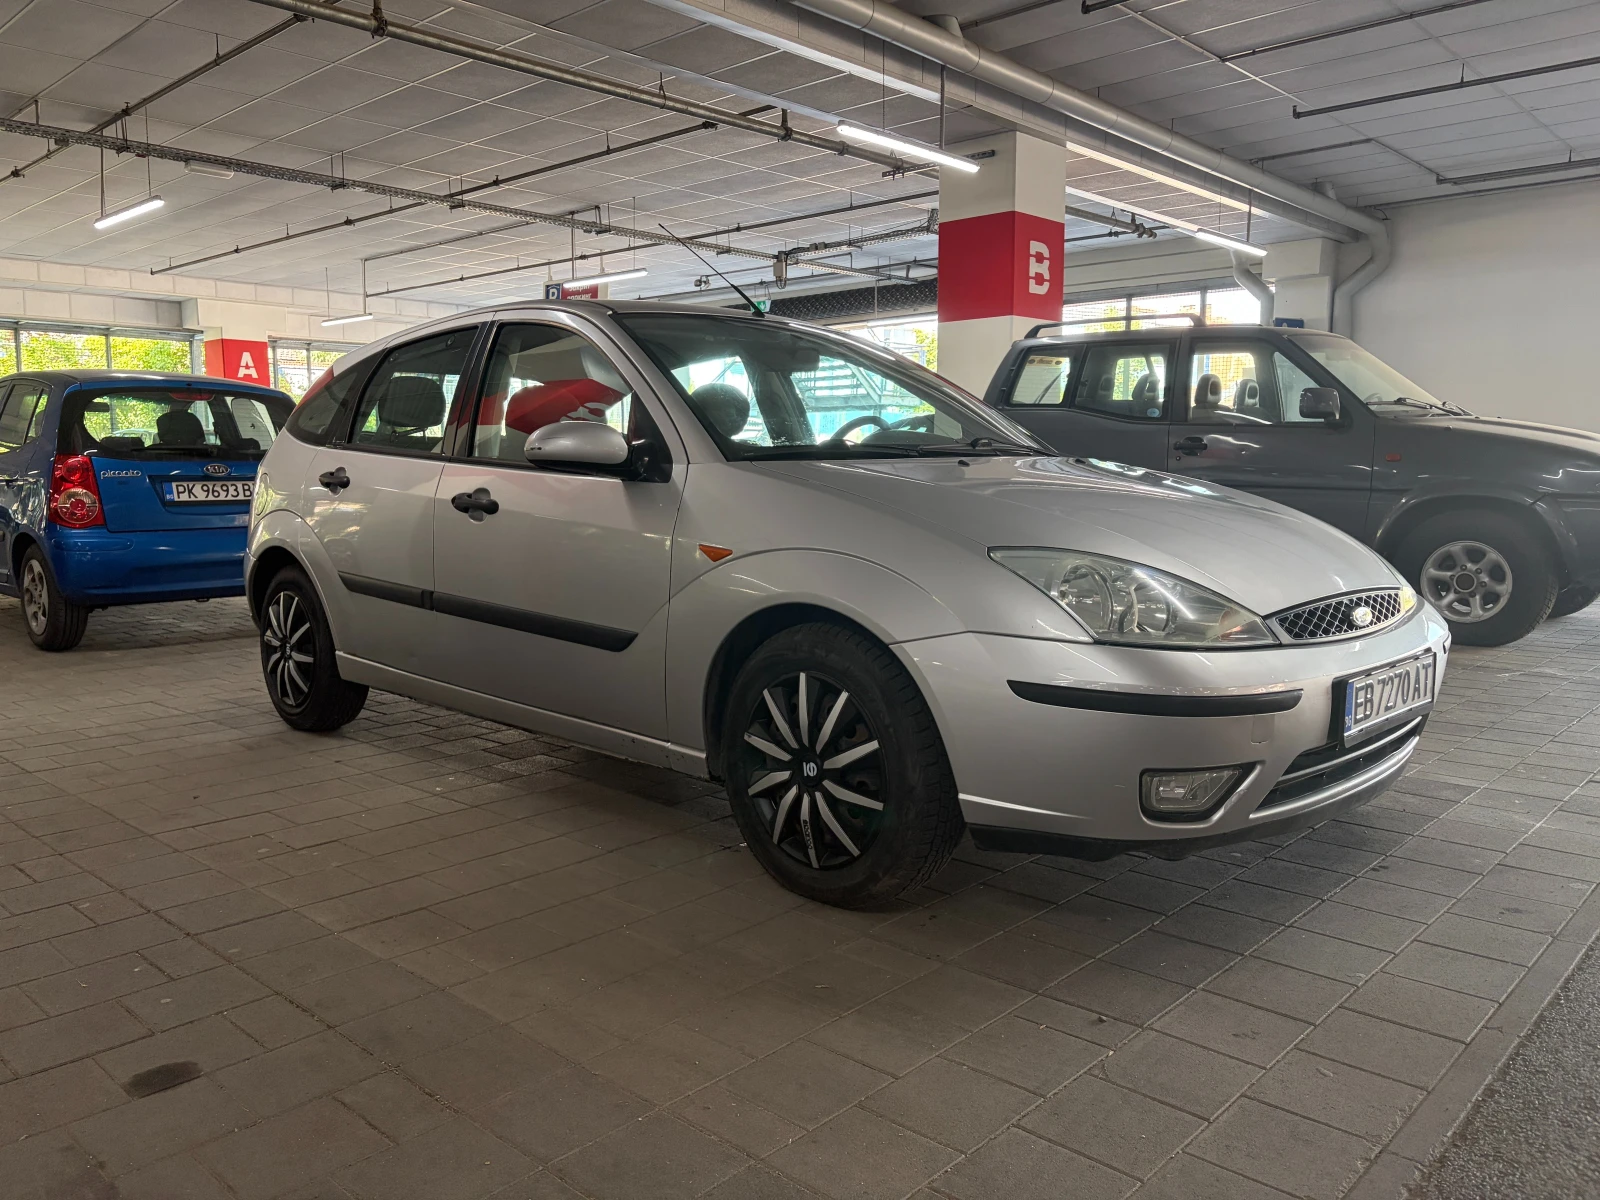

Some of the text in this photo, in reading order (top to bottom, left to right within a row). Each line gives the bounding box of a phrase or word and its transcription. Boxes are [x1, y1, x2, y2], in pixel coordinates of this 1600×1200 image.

[1029, 240, 1050, 295] B
[549, 288, 558, 299] P
[237, 351, 259, 379] A
[176, 484, 198, 499] PK
[201, 483, 240, 498] 9693
[1353, 660, 1433, 725] EB 7270 AT
